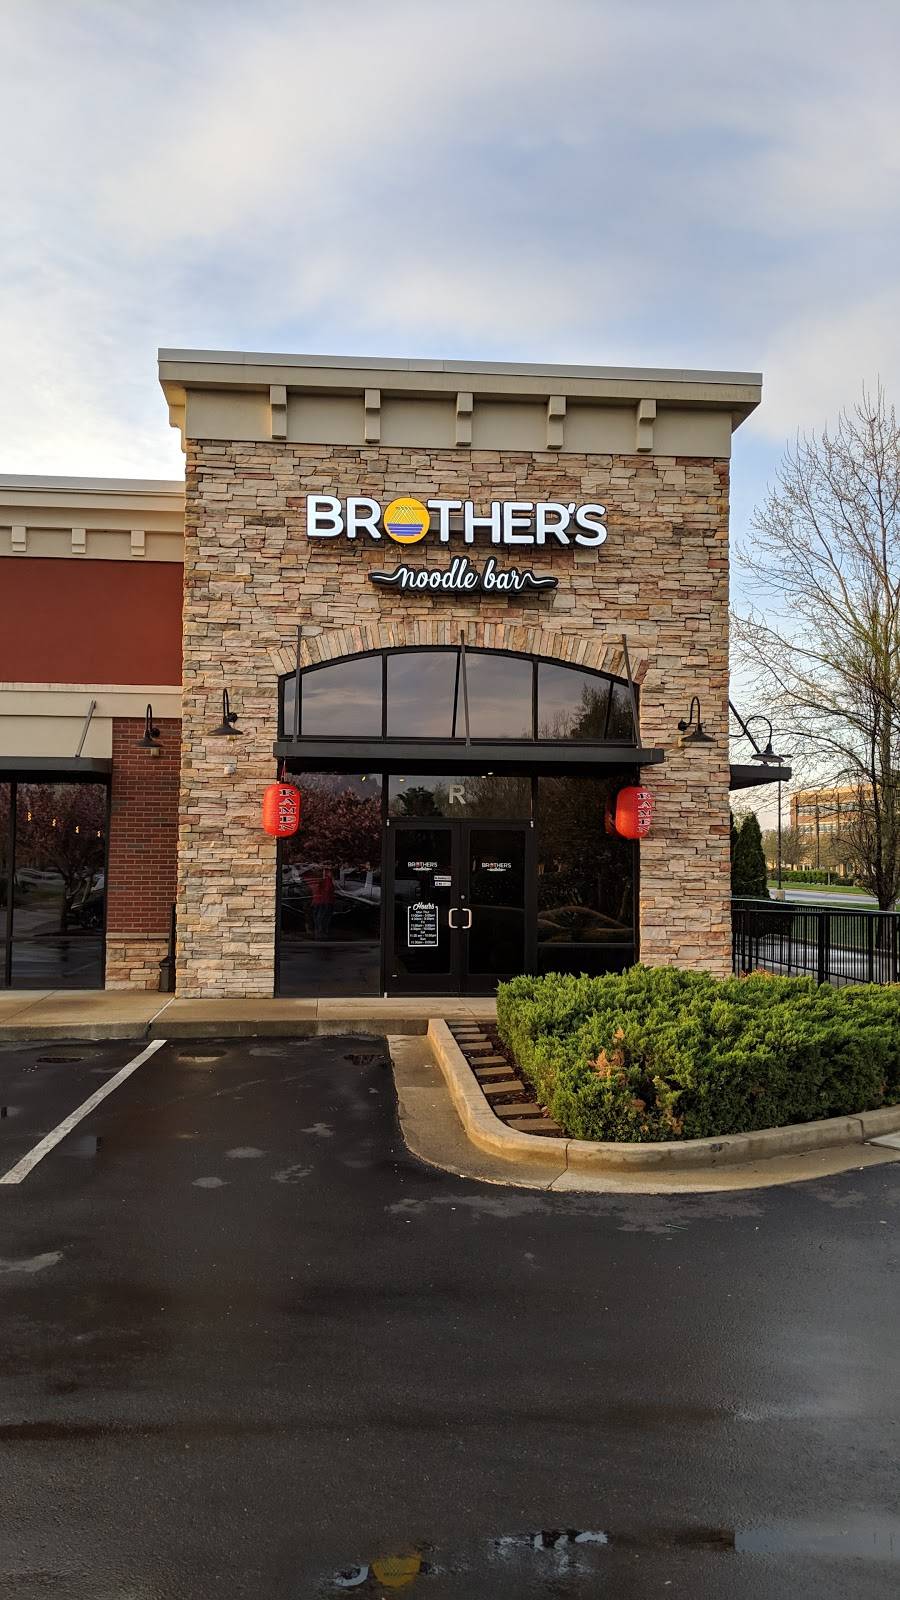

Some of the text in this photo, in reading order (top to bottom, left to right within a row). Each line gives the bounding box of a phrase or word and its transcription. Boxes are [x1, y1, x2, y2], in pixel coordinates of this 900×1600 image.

[306, 494, 608, 547] BROTHER'S
[372, 558, 554, 589] noodle bar
[279, 789, 297, 831] RAMEN
[448, 784, 466, 804] R
[637, 793, 652, 832] RAMEN
[412, 901, 435, 911] Hours
